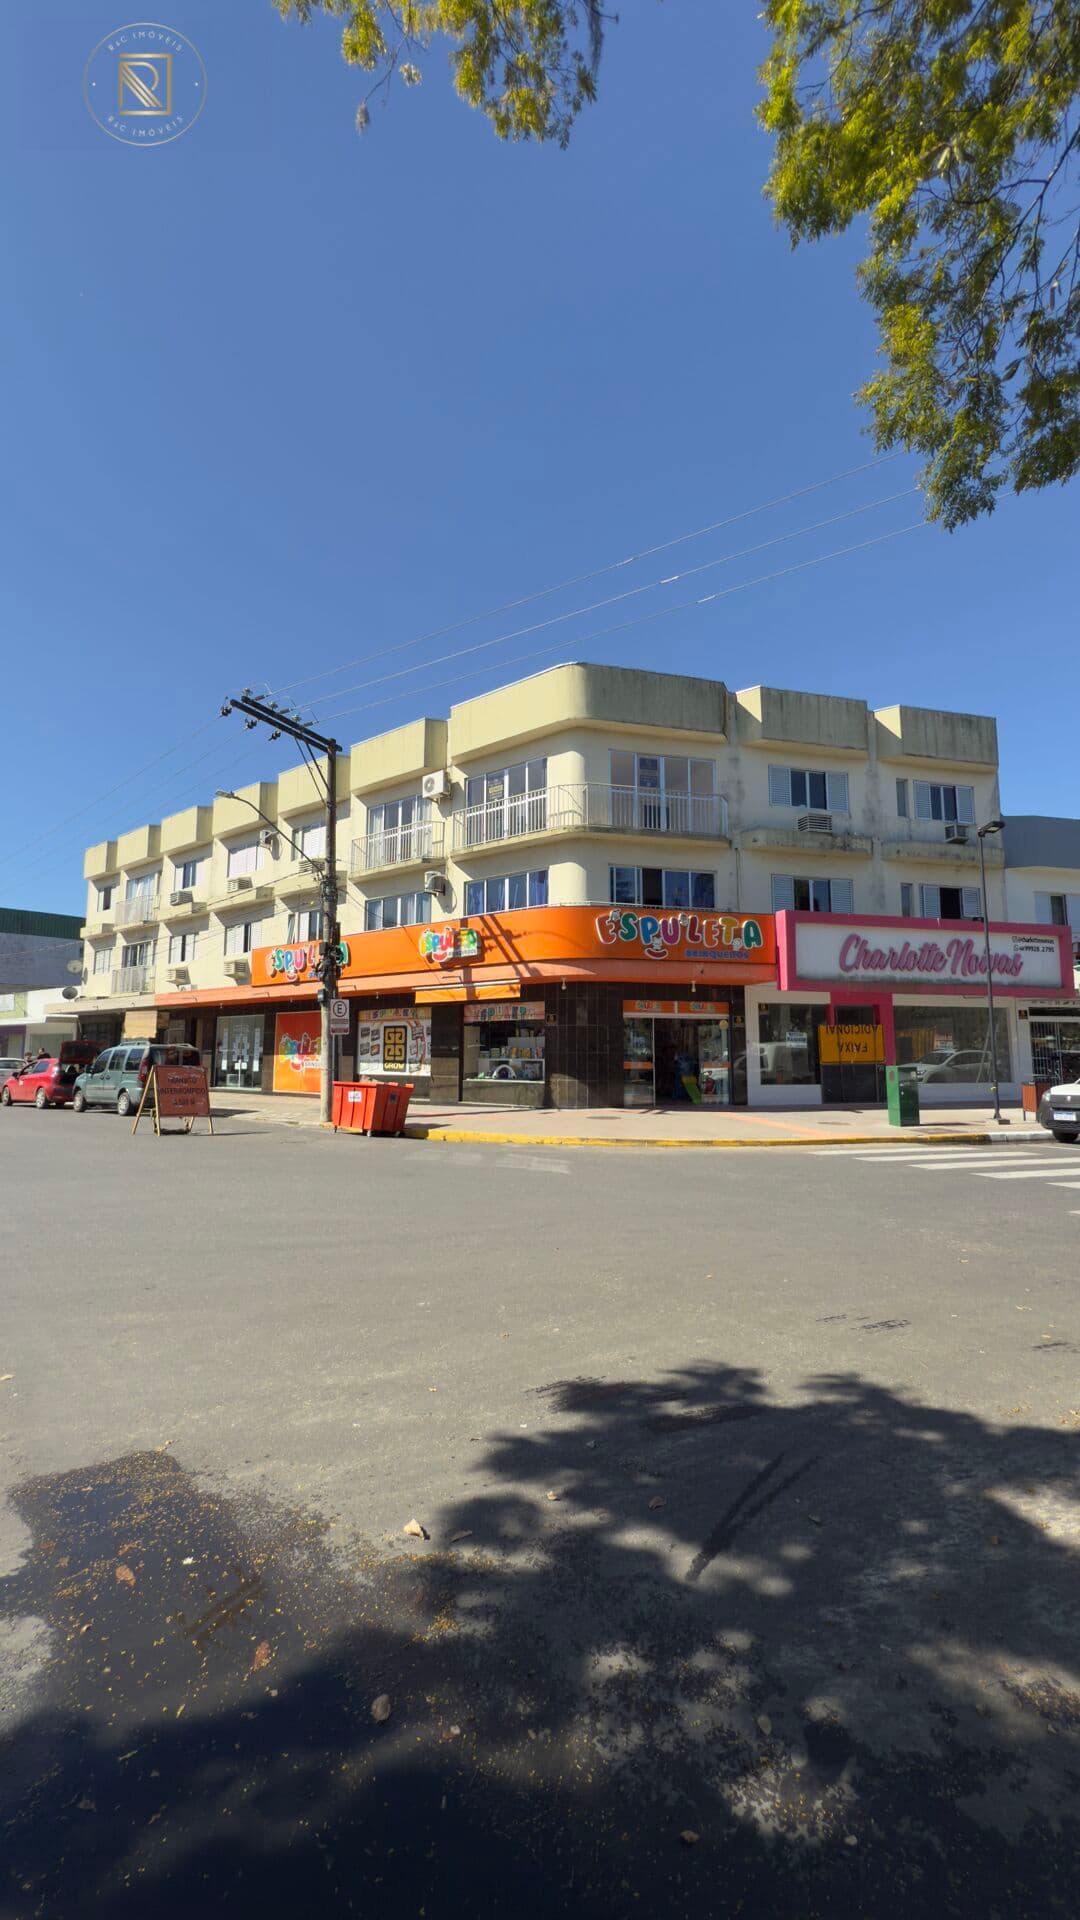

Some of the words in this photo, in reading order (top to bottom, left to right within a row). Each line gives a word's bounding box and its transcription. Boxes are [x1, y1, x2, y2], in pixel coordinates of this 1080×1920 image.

[596, 911, 763, 949] ESPULETA
[839, 934, 947, 973] Charlotte
[947, 939, 1023, 977] Noivas
[337, 1004, 343, 1014] E
[384, 1062, 405, 1070] GROW
